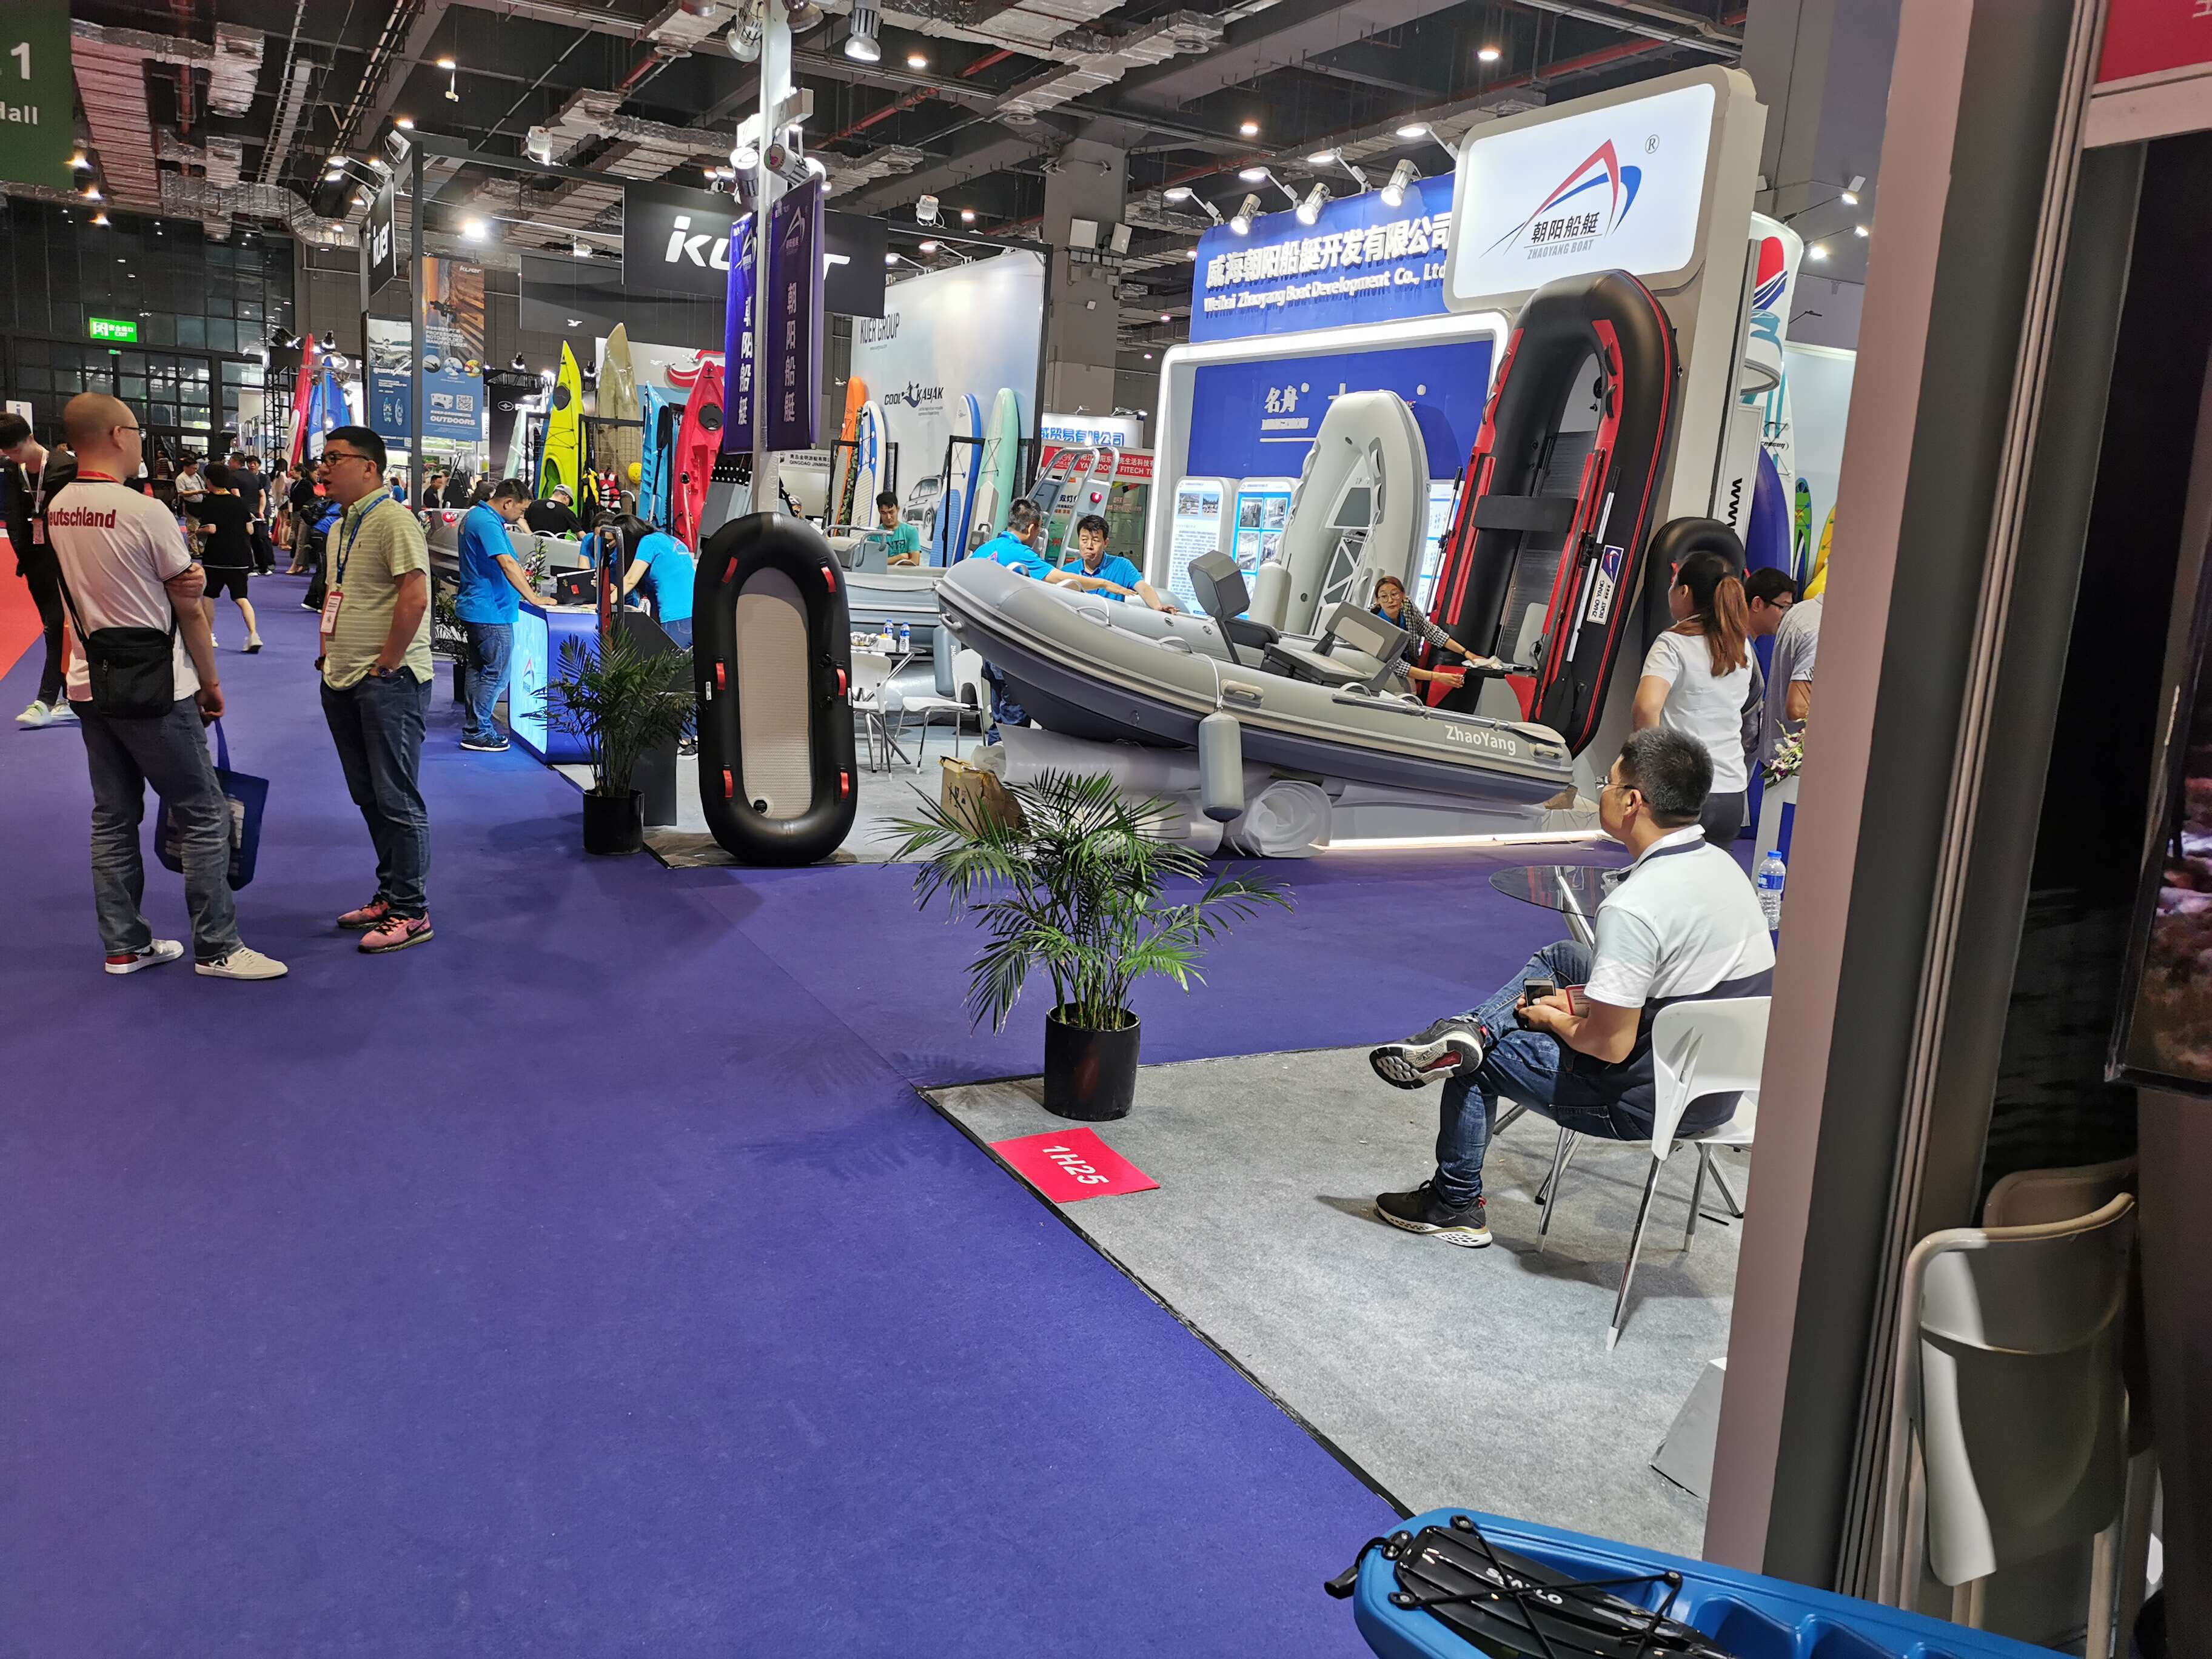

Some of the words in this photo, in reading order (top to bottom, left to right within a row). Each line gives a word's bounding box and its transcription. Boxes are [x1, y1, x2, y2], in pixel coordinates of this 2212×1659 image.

[1531, 212, 1600, 244] 朝阳船艇
[1206, 213, 1451, 288] 威海朝阳船艇开发有限公司
[1527, 243, 1569, 260] ZHAOYANG
[1571, 239, 1595, 253] BOAT
[1311, 270, 1391, 297] Development
[783, 281, 797, 423] 朝阳船艇
[430, 415, 475, 426] OUTDOORS
[1445, 725, 1516, 756] ZhaoYang
[1042, 1145, 1110, 1185] 1H25
